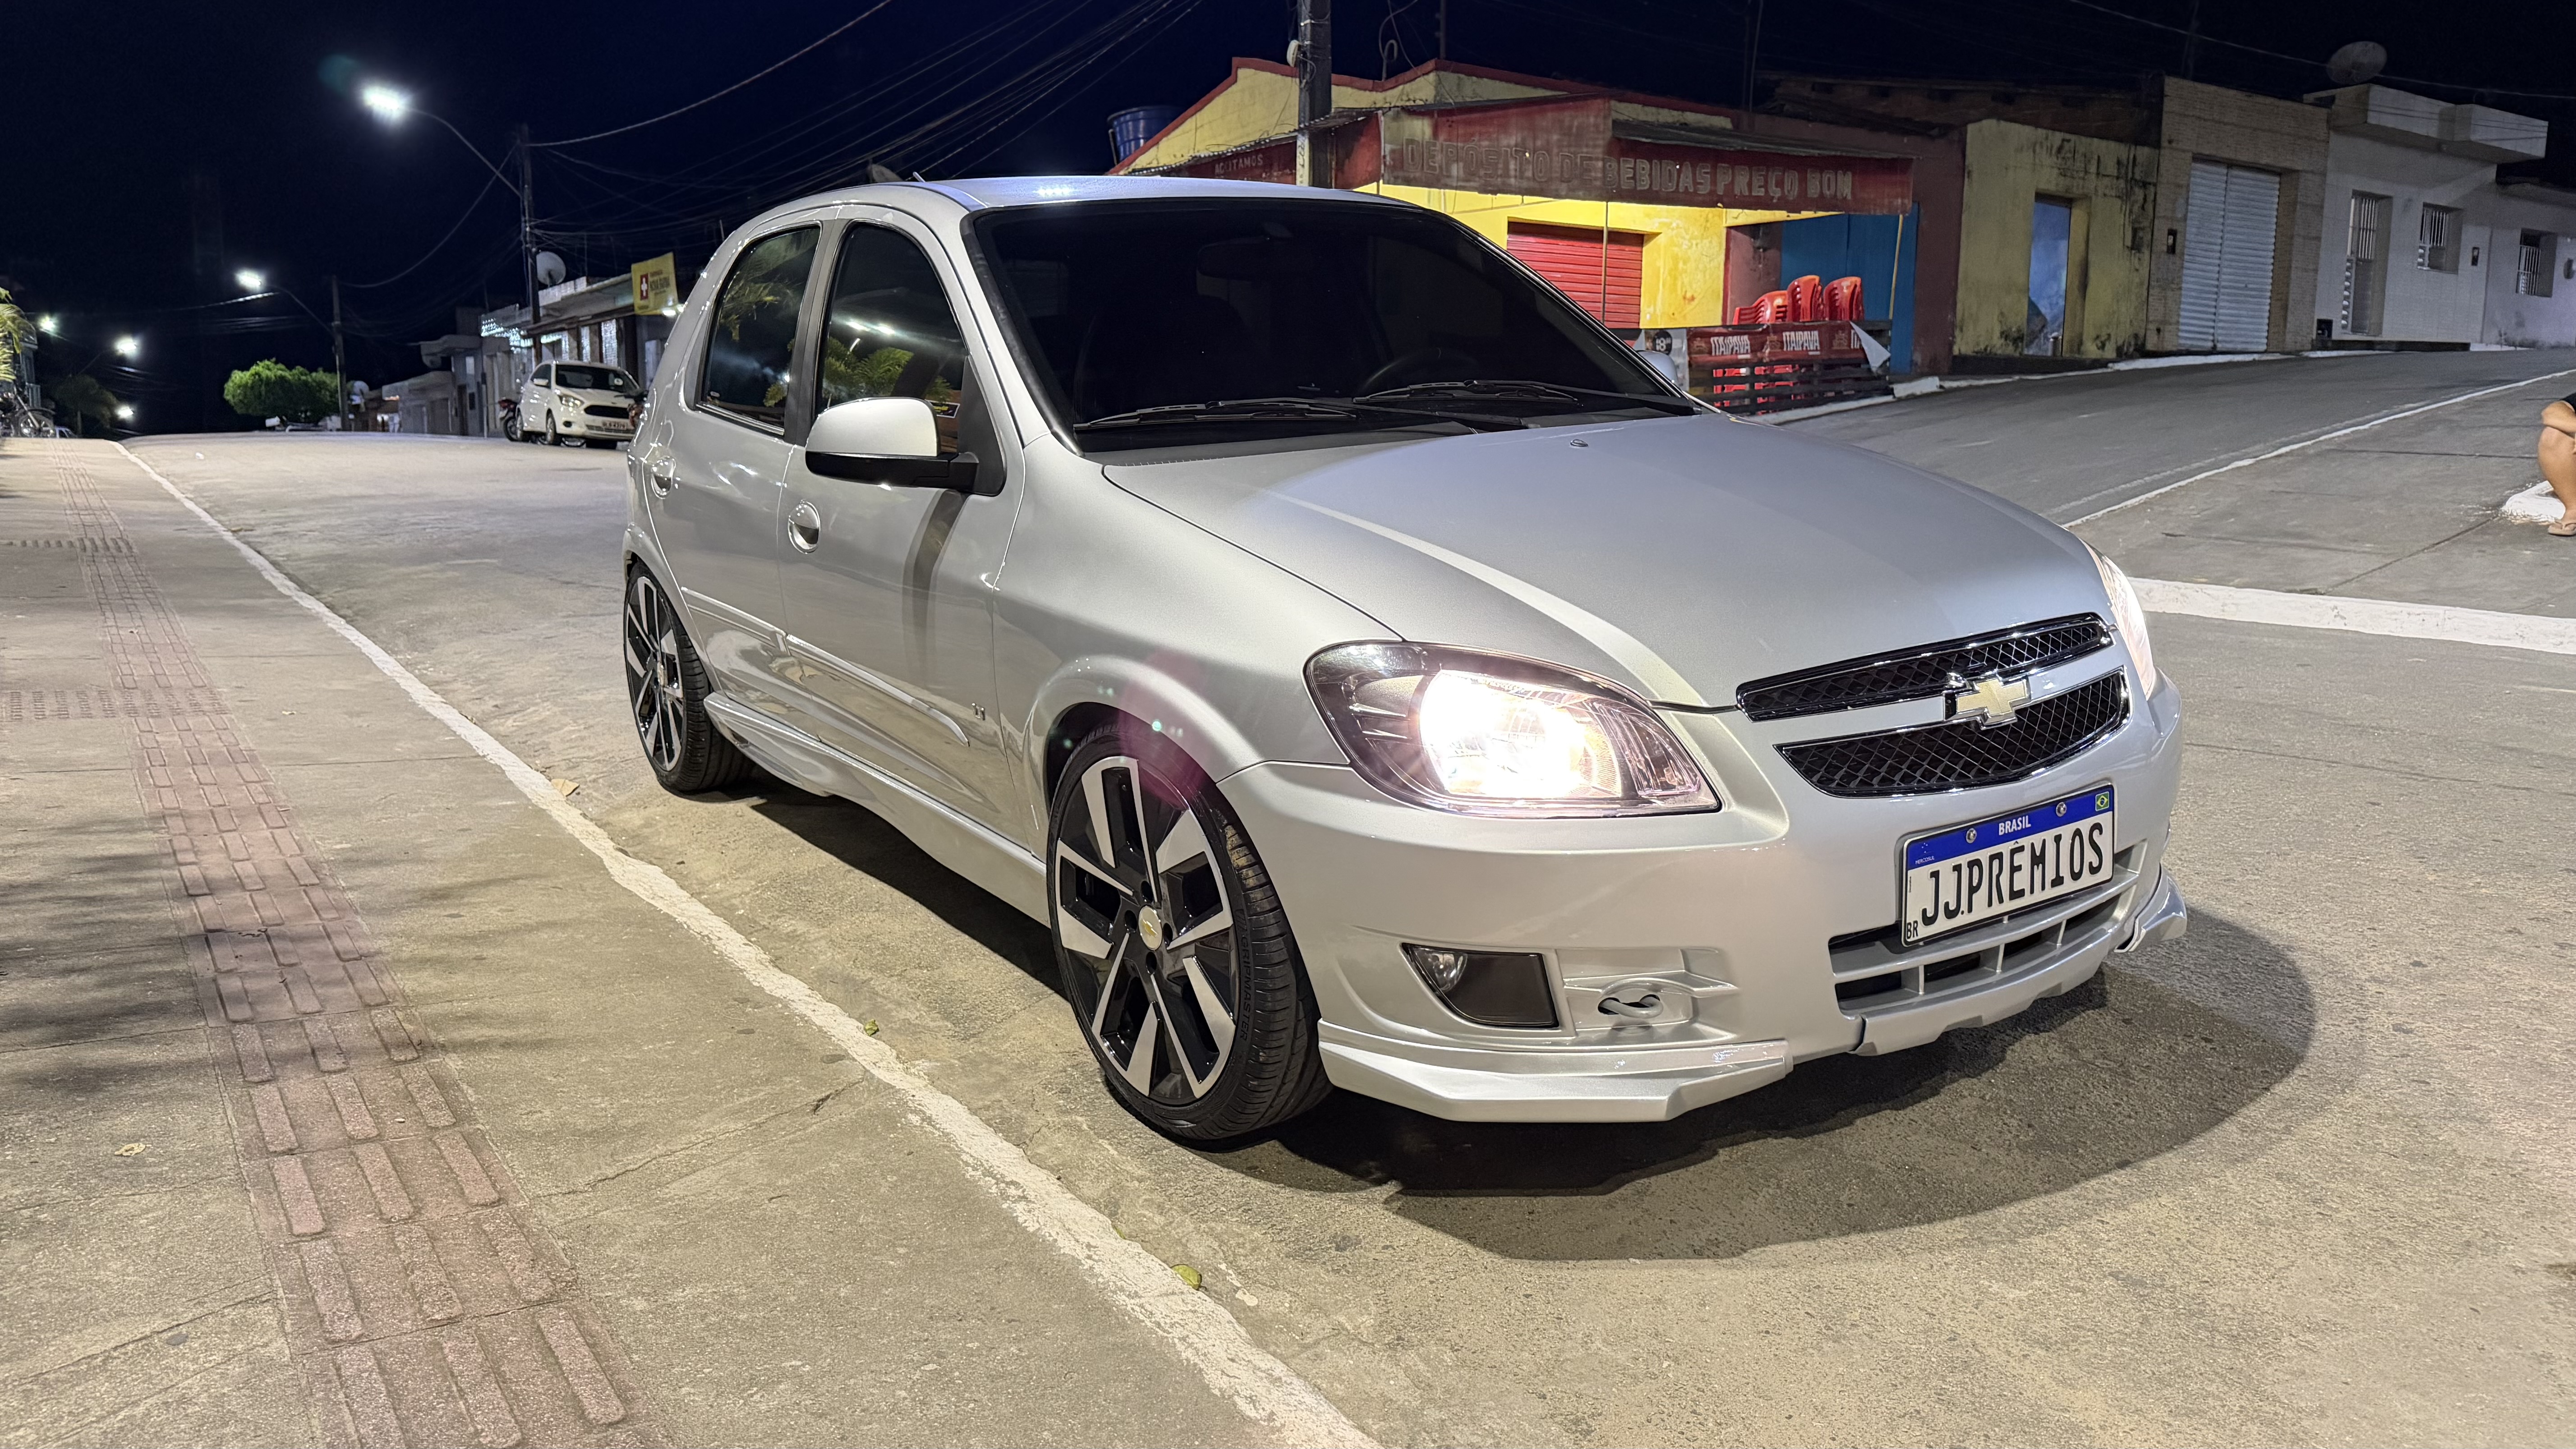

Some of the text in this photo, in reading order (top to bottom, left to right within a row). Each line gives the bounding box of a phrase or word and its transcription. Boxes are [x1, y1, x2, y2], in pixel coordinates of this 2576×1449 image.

[1214, 154, 1263, 175] ACITAMOS
[1403, 137, 1853, 202] DEPÓSITO DE BEBIDAS PREÇO BOM
[1711, 335, 1751, 356] ITAIPAVA
[1782, 330, 1820, 351] ITAIPAVA
[1999, 815, 2032, 836] BRASIL
[1906, 920, 1918, 940] BR
[1240, 935, 1251, 1041] GRIPMASTER
